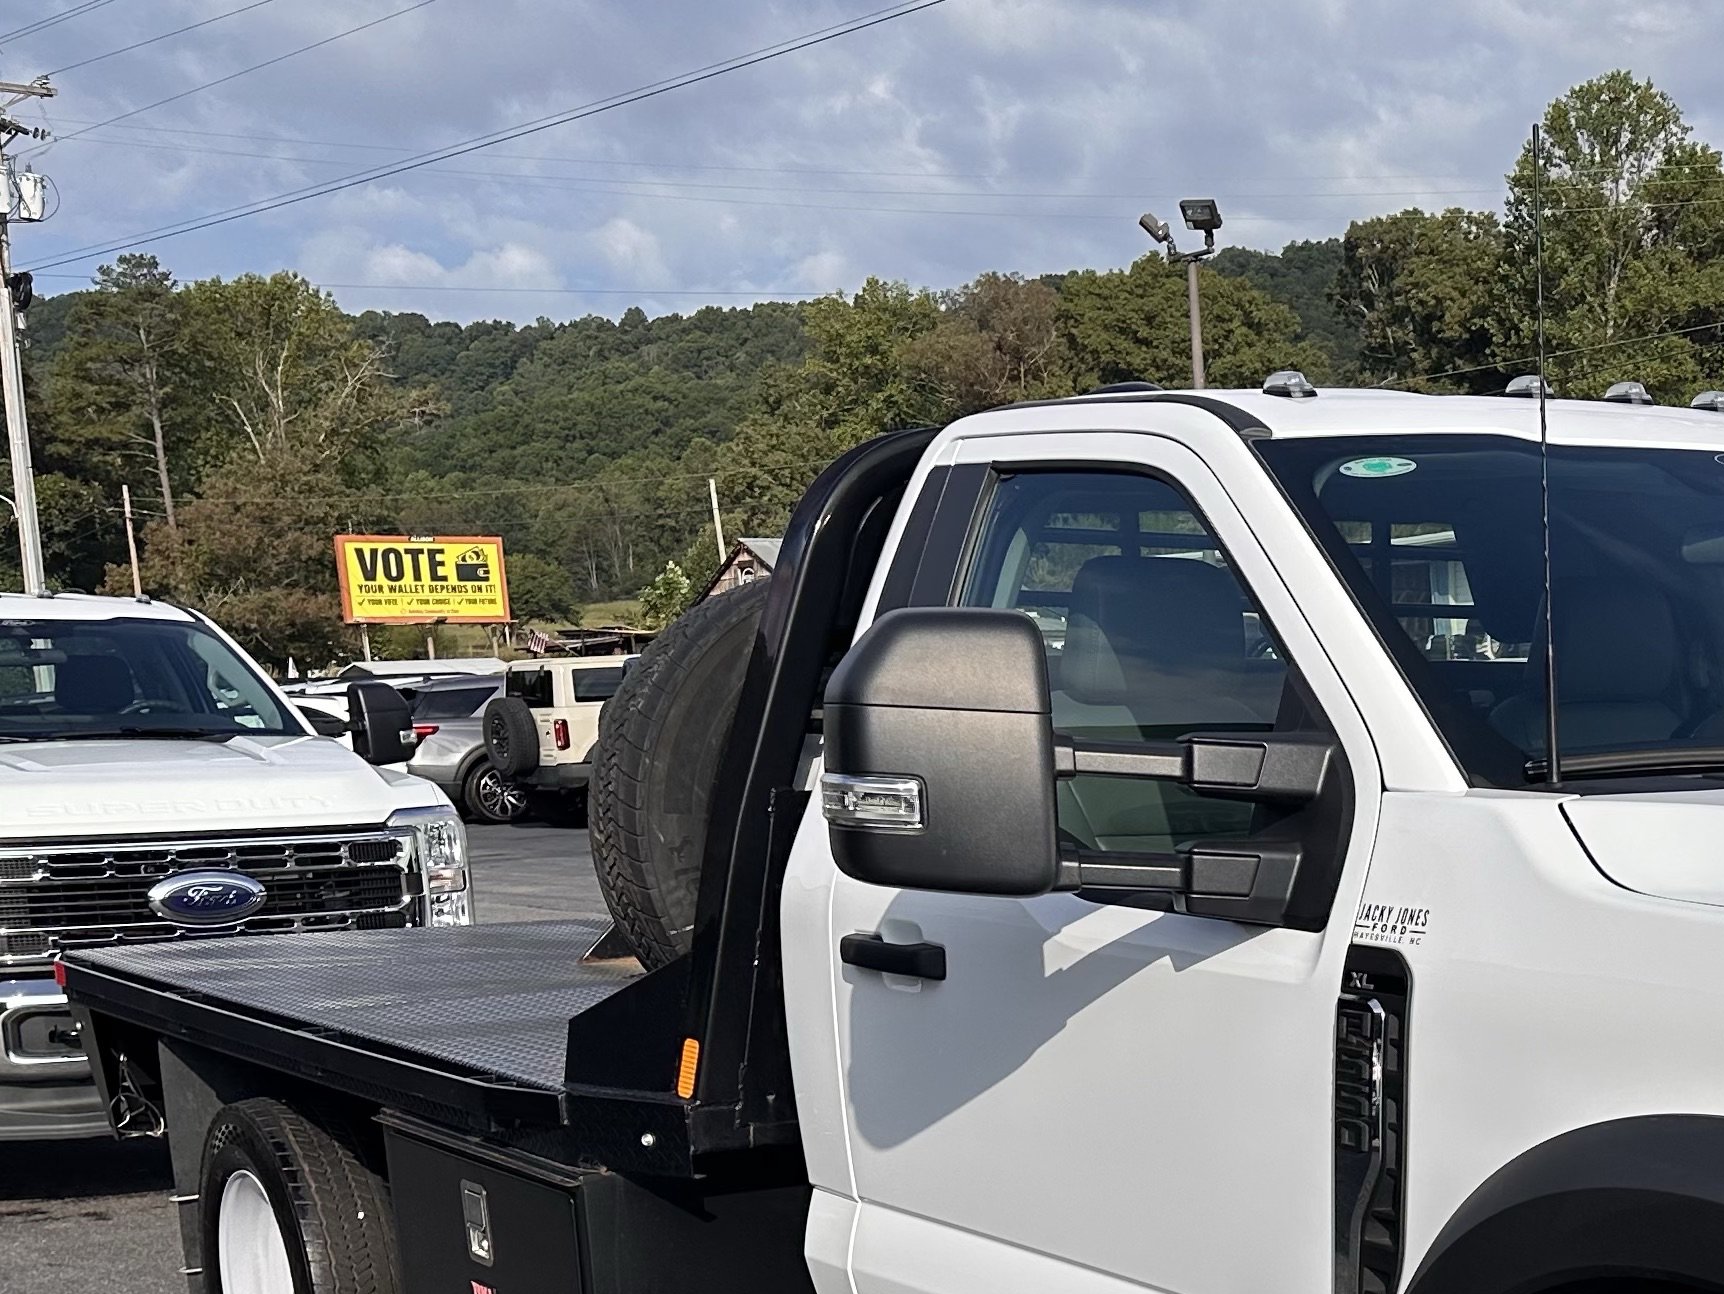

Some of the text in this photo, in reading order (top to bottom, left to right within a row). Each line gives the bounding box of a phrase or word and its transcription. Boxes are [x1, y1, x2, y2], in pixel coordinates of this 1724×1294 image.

[354, 547, 448, 582] VOTE
[358, 584, 496, 594] YOUR WALLET DEPENDS ON IT!
[1359, 903, 1430, 927] JACKY JONES
[1371, 922, 1407, 935] FORD
[1409, 937, 1421, 946] NC
[1350, 971, 1375, 990] XL
